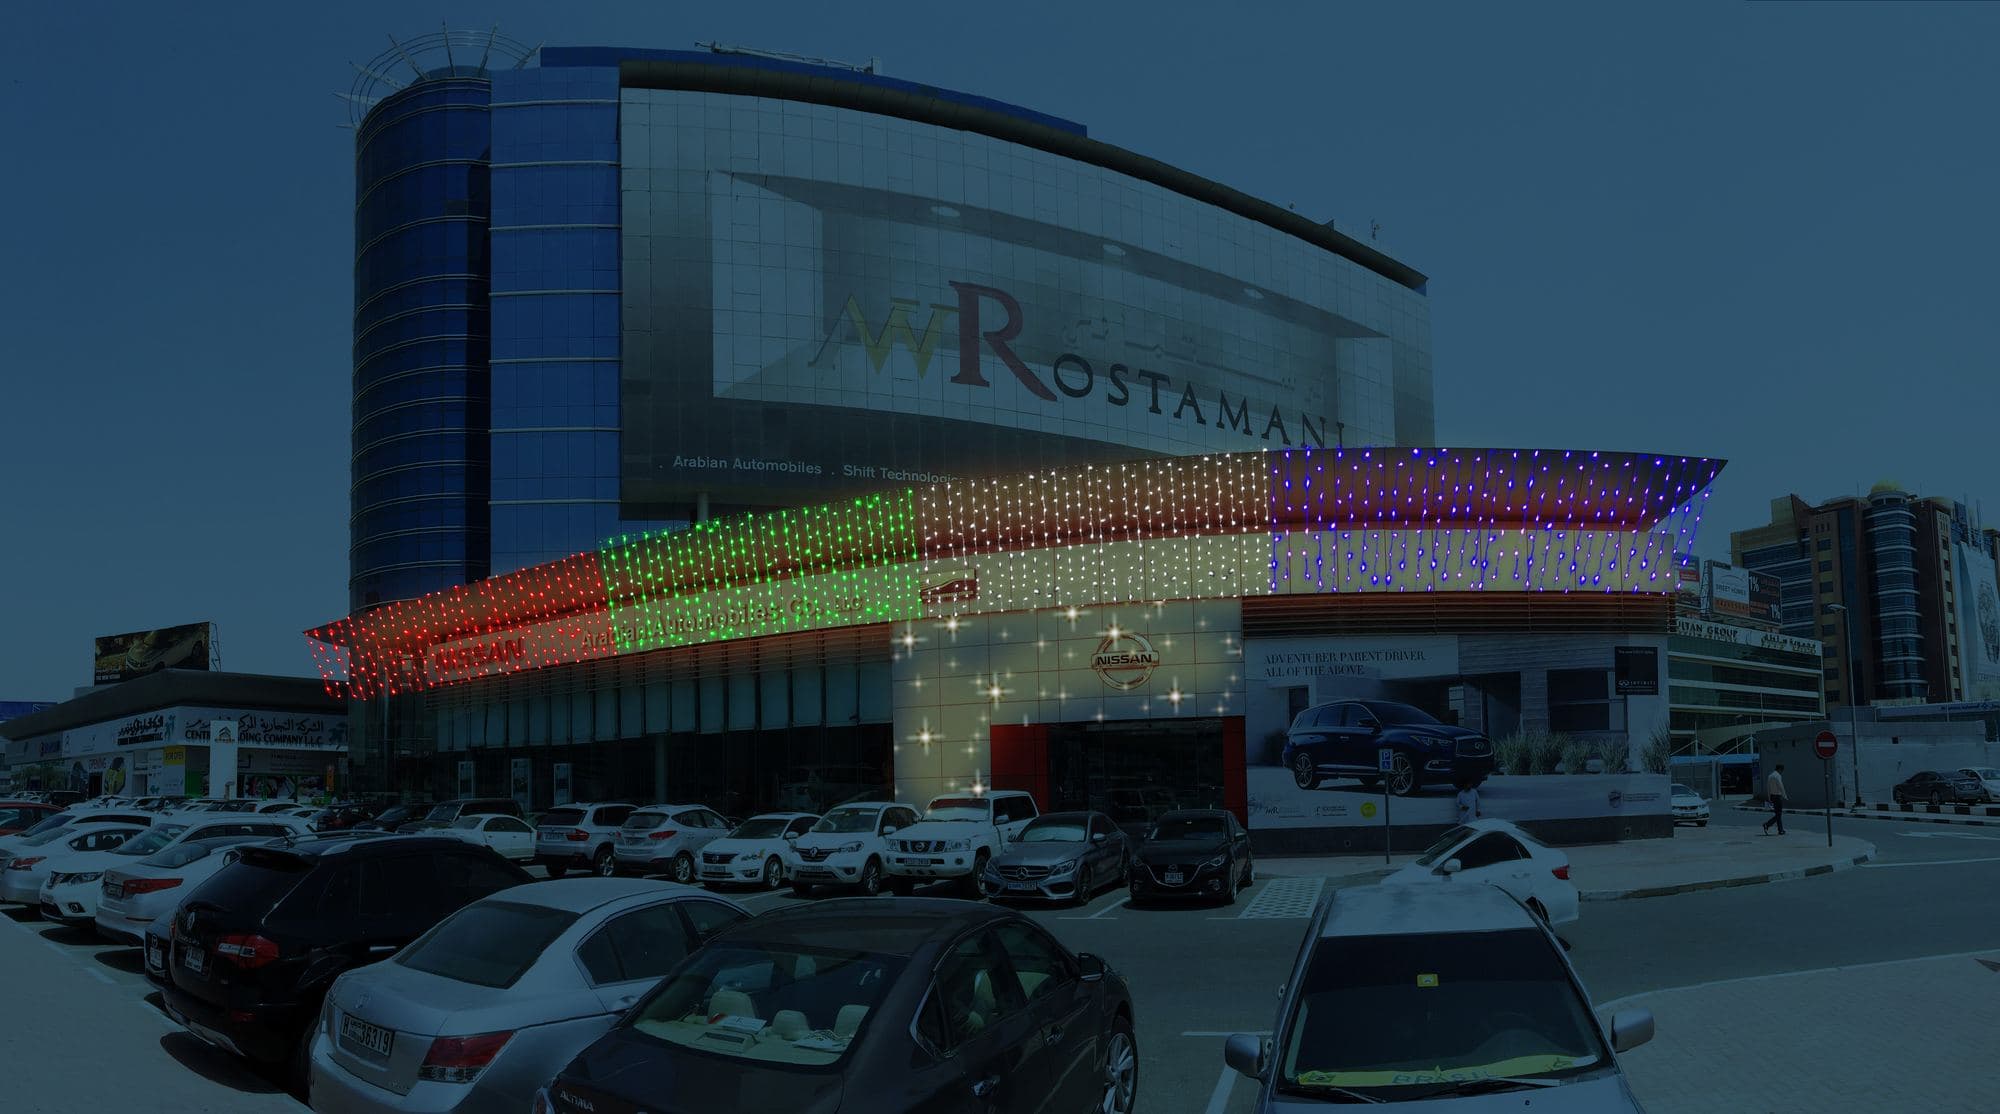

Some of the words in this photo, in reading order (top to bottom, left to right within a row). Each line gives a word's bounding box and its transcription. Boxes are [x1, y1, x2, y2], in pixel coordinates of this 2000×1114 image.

[672, 456, 727, 470] Arabian
[732, 457, 822, 475] Automobiles
[843, 464, 876, 479] Shift
[652, 600, 780, 636] Automobiles
[1707, 626, 1738, 638] GROUP
[435, 637, 525, 672] NISSAN
[1097, 654, 1152, 666] NISSAN
[1264, 666, 1285, 677] ALL
[1302, 665, 1325, 676] THE
[264, 734, 302, 746] COMPANY
[359, 1023, 390, 1053] 36319
